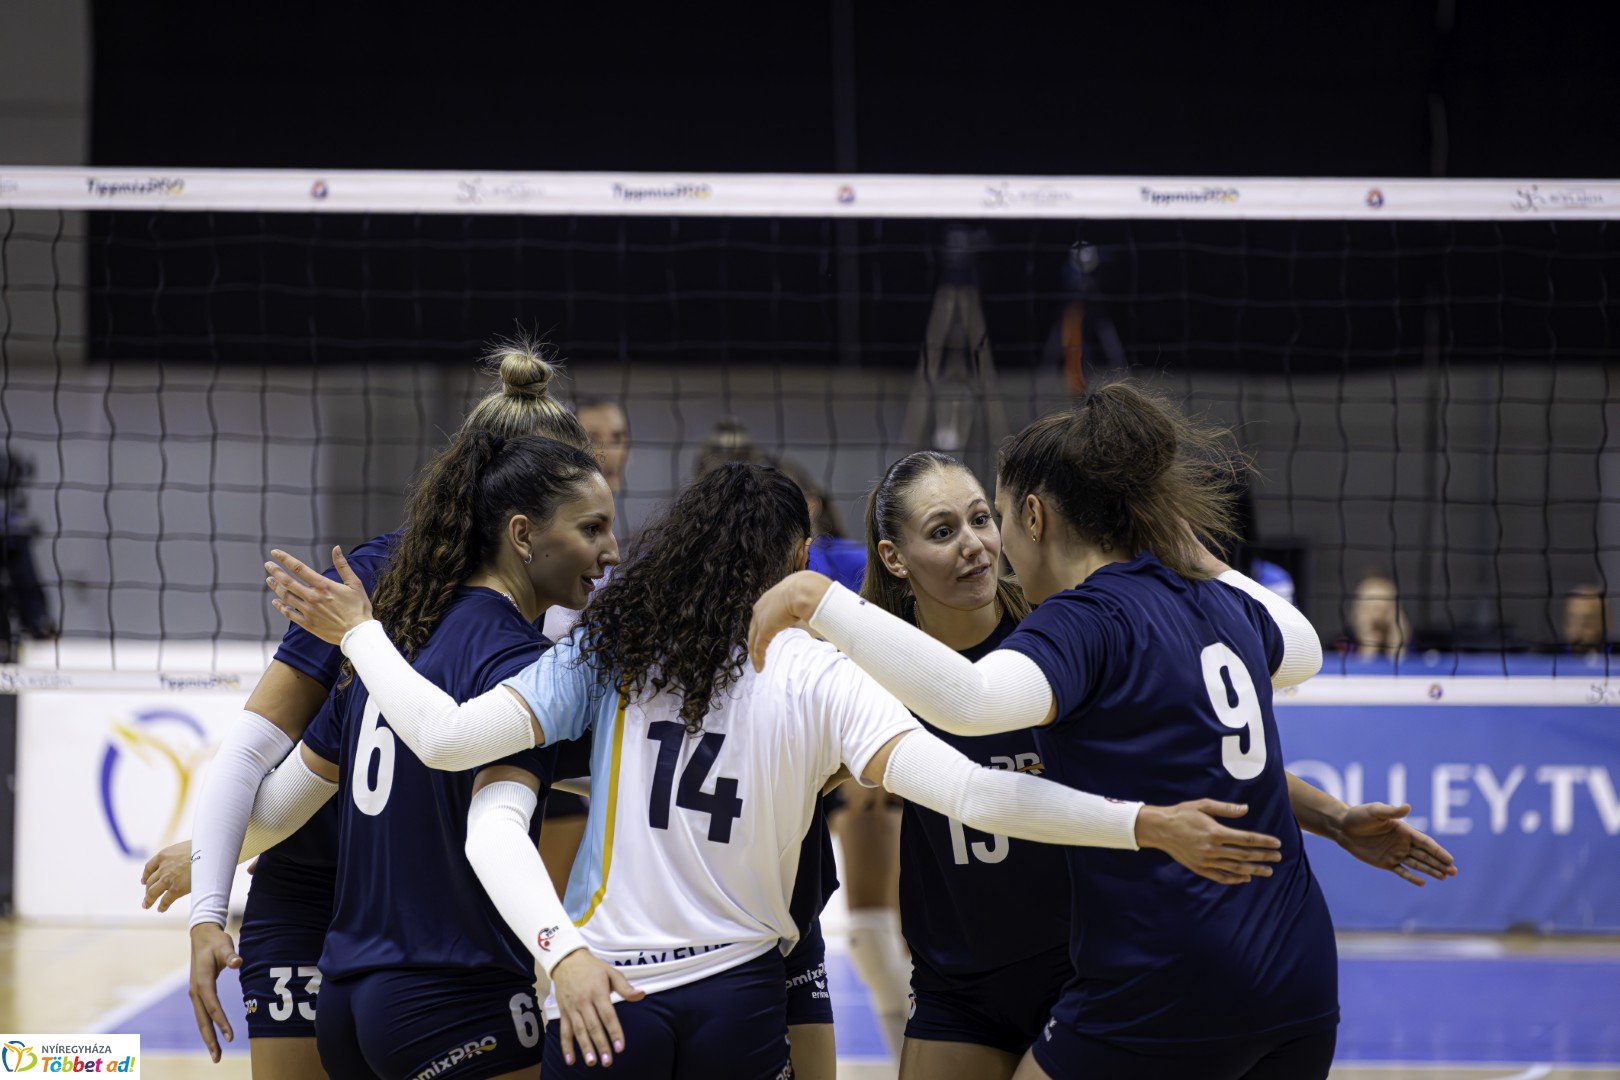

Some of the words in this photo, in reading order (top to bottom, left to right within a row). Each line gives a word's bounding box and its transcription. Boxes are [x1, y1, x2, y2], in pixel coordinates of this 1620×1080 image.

[352, 695, 396, 816] 6
[1200, 642, 1267, 780] 9
[647, 720, 743, 844] 14
[269, 966, 323, 1021] 33
[509, 992, 540, 1049] 6
[411, 1035, 498, 1080] mixPRO
